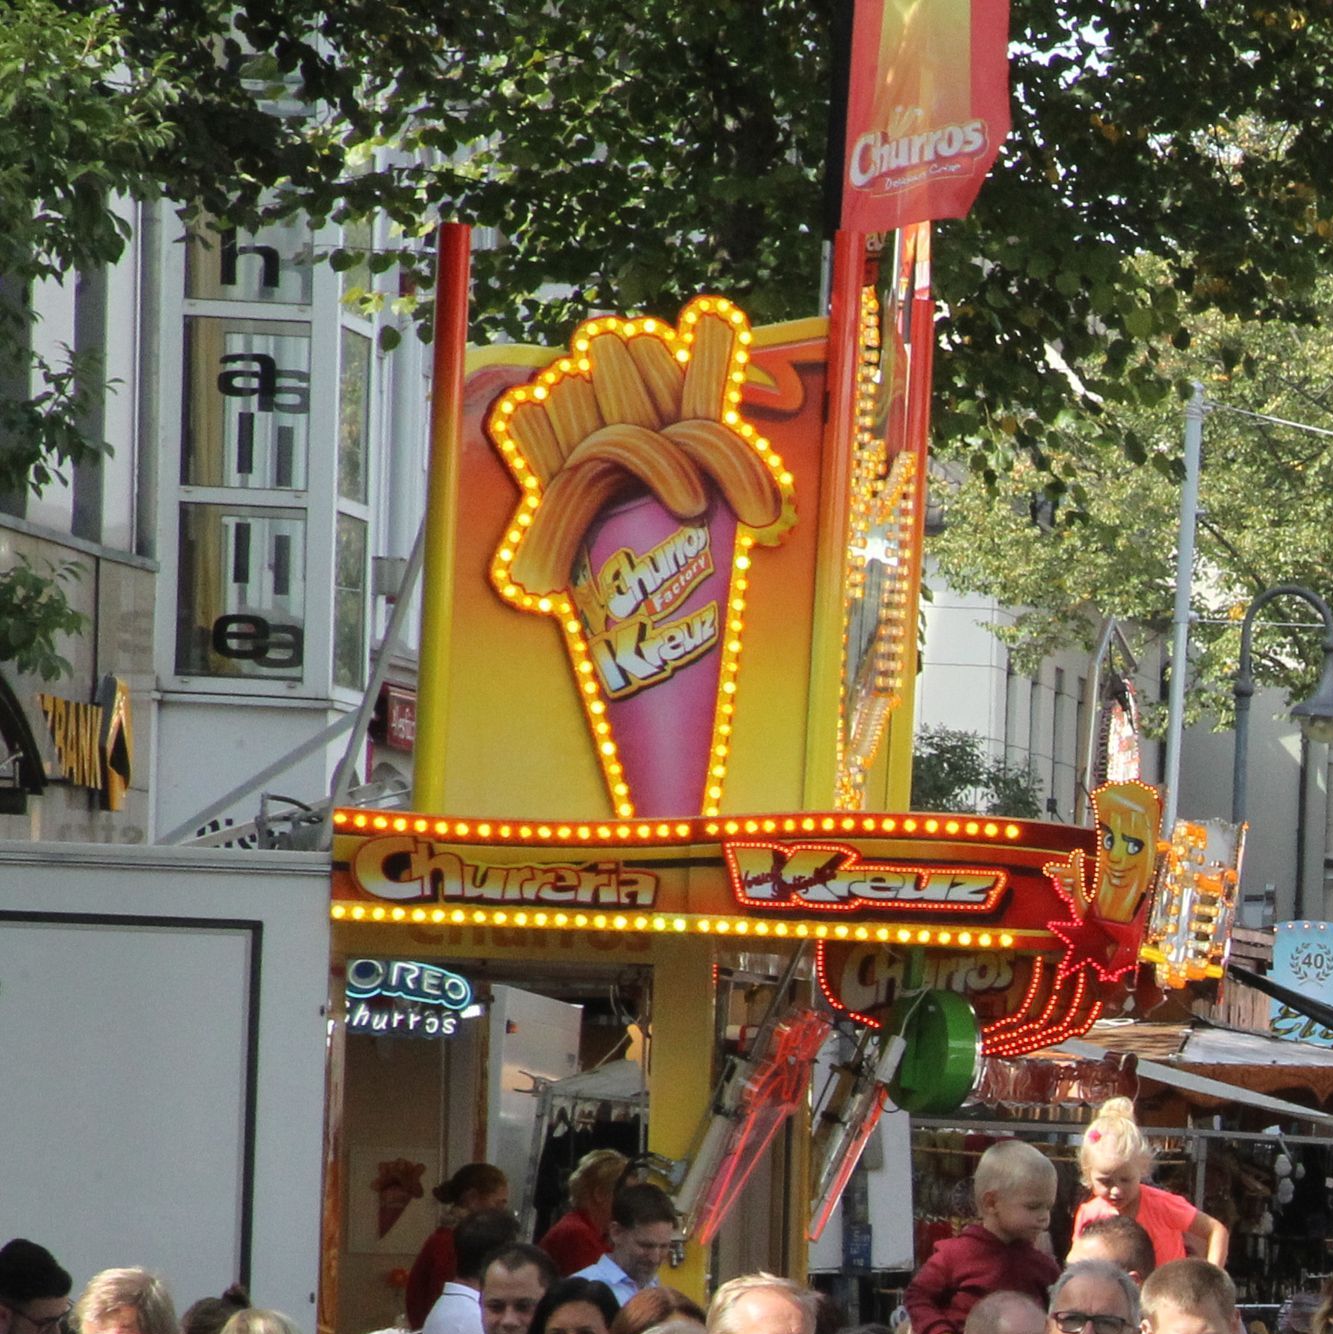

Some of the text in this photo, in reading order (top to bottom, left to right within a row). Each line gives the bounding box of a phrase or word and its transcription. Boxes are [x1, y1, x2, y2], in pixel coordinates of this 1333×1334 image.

[851, 120, 985, 187] Churros
[655, 557, 707, 612] Factory
[592, 607, 717, 692] Kreuz
[355, 836, 657, 904] Churreria
[731, 846, 1002, 905] Kreuz
[349, 958, 467, 1000] OREO
[1301, 953, 1325, 970] 40
